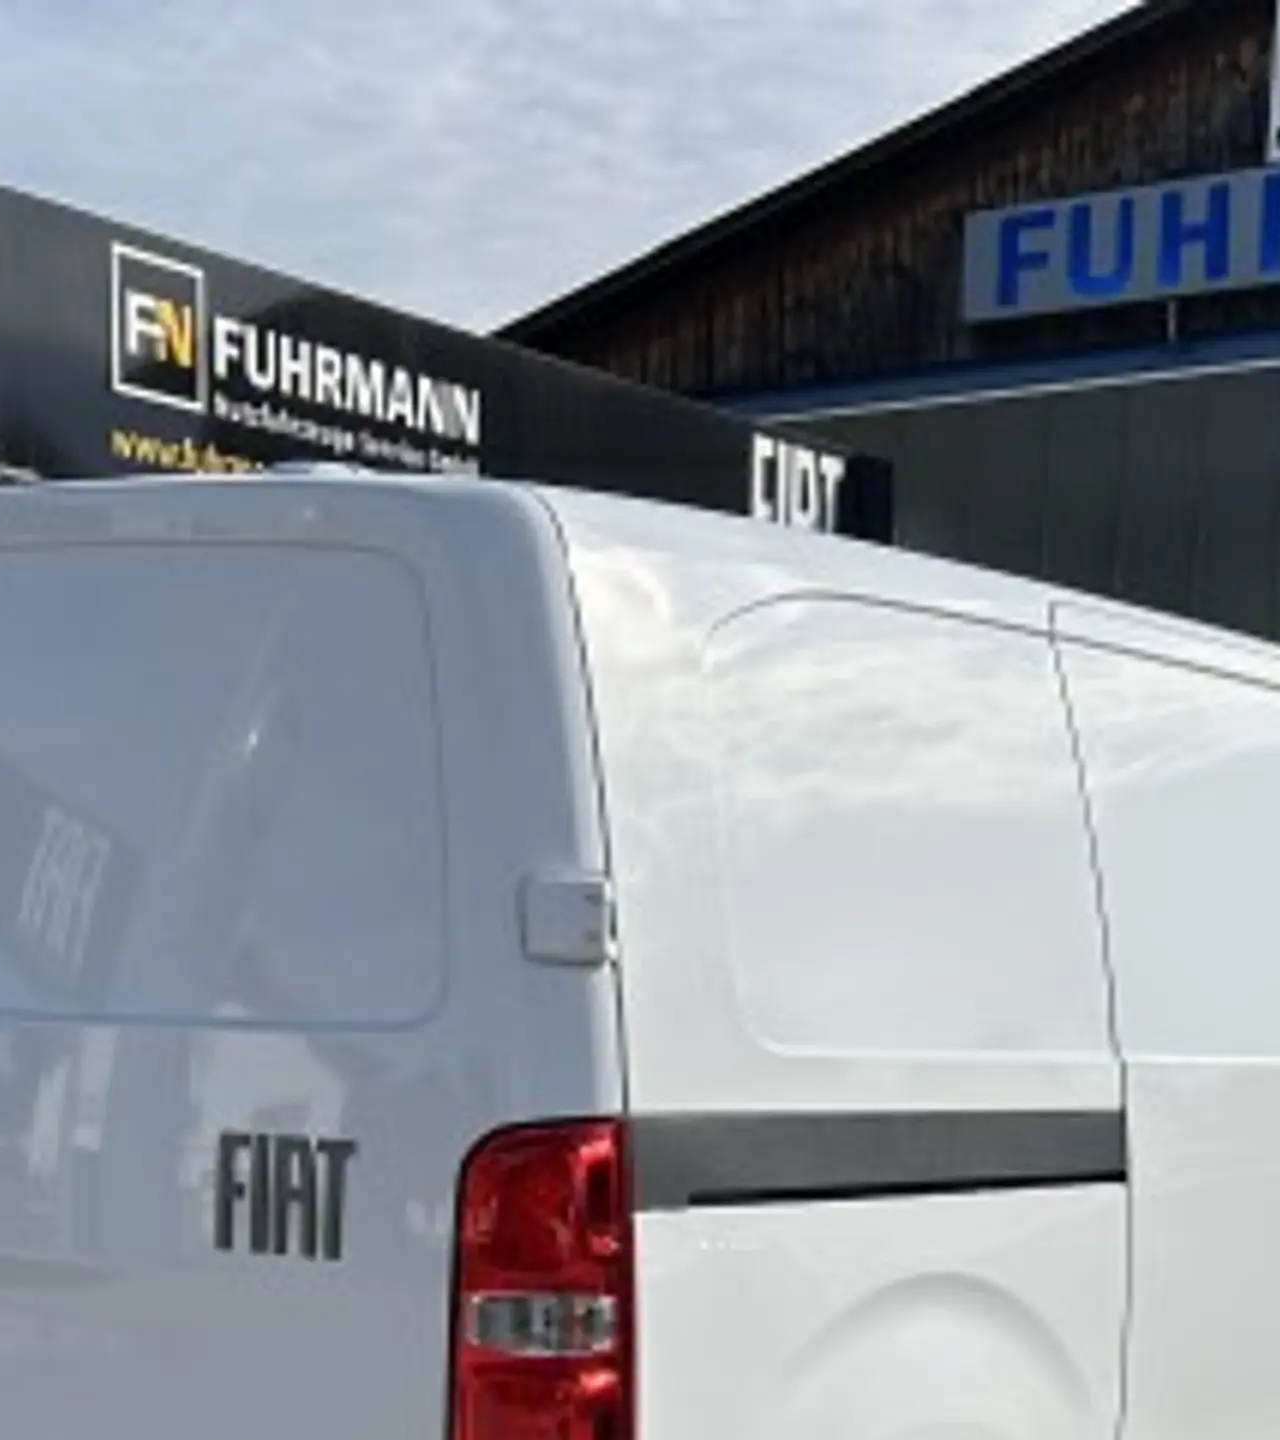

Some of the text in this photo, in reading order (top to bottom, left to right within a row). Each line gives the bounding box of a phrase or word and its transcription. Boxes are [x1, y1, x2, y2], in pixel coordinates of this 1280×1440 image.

[213, 313, 482, 446] FUHRMANN
[752, 432, 846, 536] FIAT
[215, 1132, 358, 1262] FIAT
